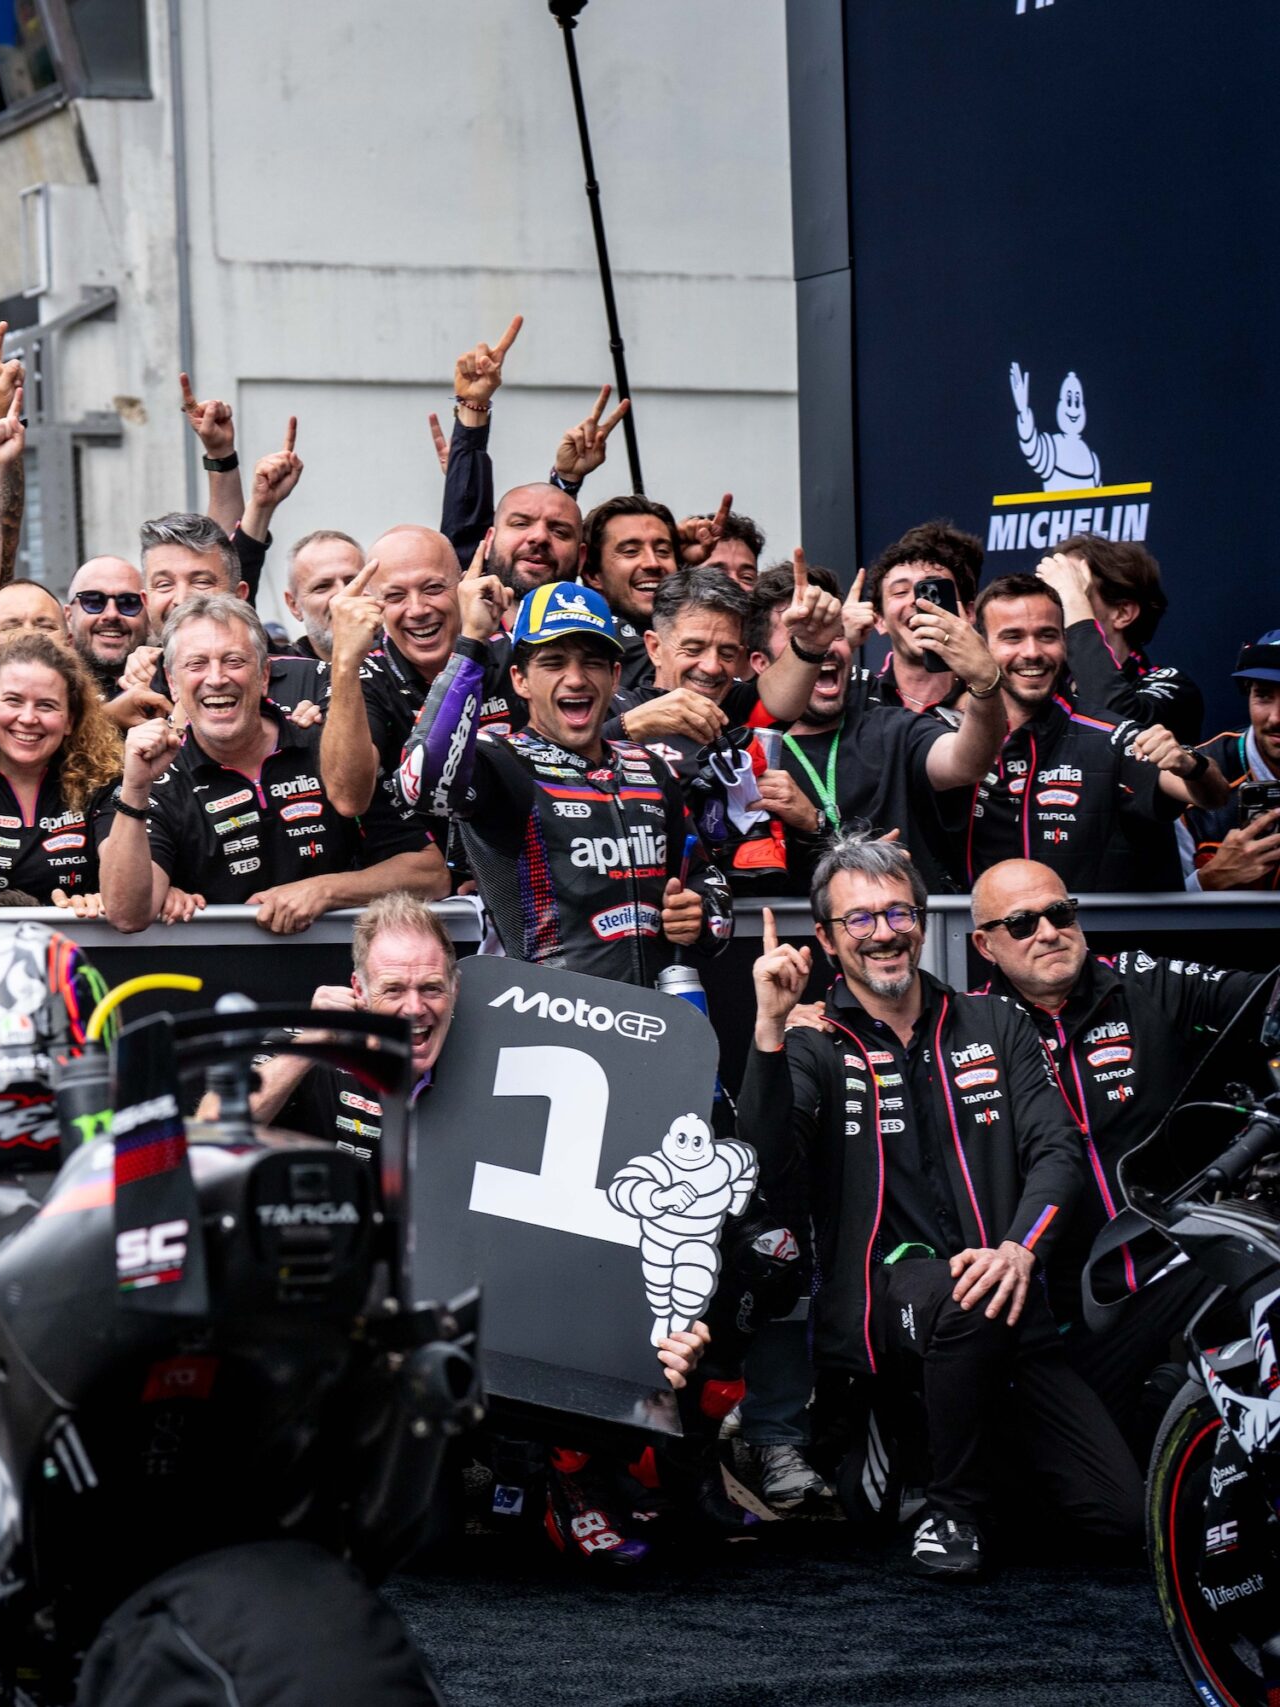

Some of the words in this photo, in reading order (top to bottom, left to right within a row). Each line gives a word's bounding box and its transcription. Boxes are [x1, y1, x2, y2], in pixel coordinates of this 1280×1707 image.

[987, 503, 1150, 550] MICHELIN
[545, 612, 605, 629] MICHELIN
[428, 693, 477, 817] lpinestars
[548, 744, 587, 768] aprilia
[1037, 764, 1082, 785] aprilia
[270, 775, 320, 799] aprilia
[216, 790, 250, 810] Castrol
[565, 804, 587, 816] FES
[39, 810, 84, 832] aprilia
[1038, 812, 1077, 821] TARGA
[286, 824, 326, 837] TARGA
[223, 836, 260, 852] BS
[570, 825, 667, 875] aprilia
[47, 856, 87, 866] TARGA
[488, 986, 666, 1042] MotoGP
[1094, 1067, 1135, 1082] TARGA
[961, 1090, 1002, 1105] TARGA
[336, 1140, 372, 1159] BS
[469, 1045, 642, 1249] 1
[256, 1202, 360, 1226] TARGA
[116, 1220, 189, 1271] SC
[1220, 1464, 1237, 1478] PAN
[1206, 1520, 1238, 1546] SC
[1213, 1574, 1264, 1606] Lifenet.it
